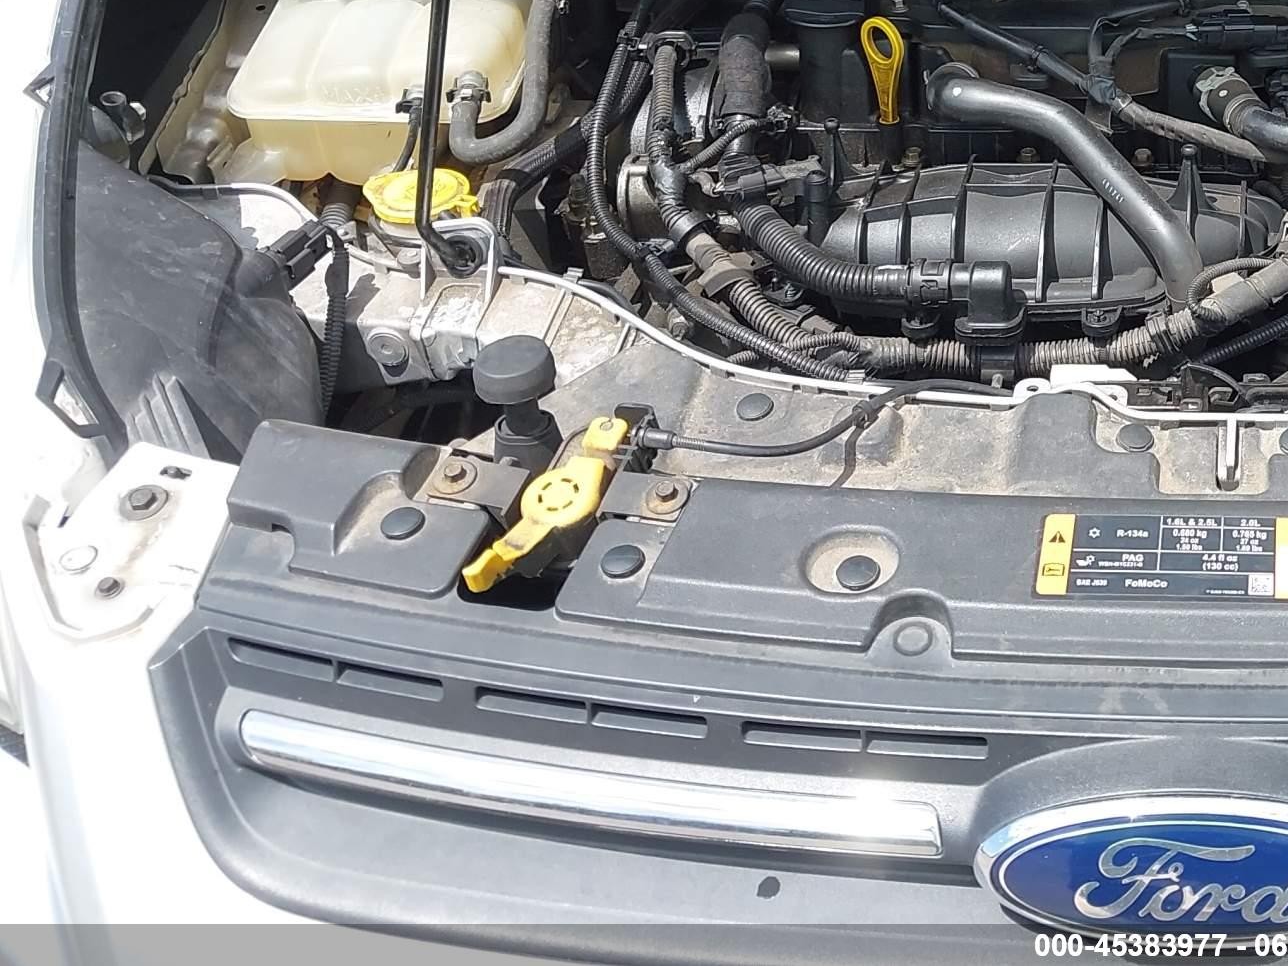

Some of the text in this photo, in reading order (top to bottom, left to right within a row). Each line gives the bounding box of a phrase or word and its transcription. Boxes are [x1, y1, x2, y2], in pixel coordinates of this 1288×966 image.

[1197, 529, 1207, 538] kg
[1256, 531, 1267, 540] kg
[1122, 554, 1144, 562] PAG
[1202, 562, 1239, 571] (130 cc)
[1125, 579, 1168, 588] FoMoCo
